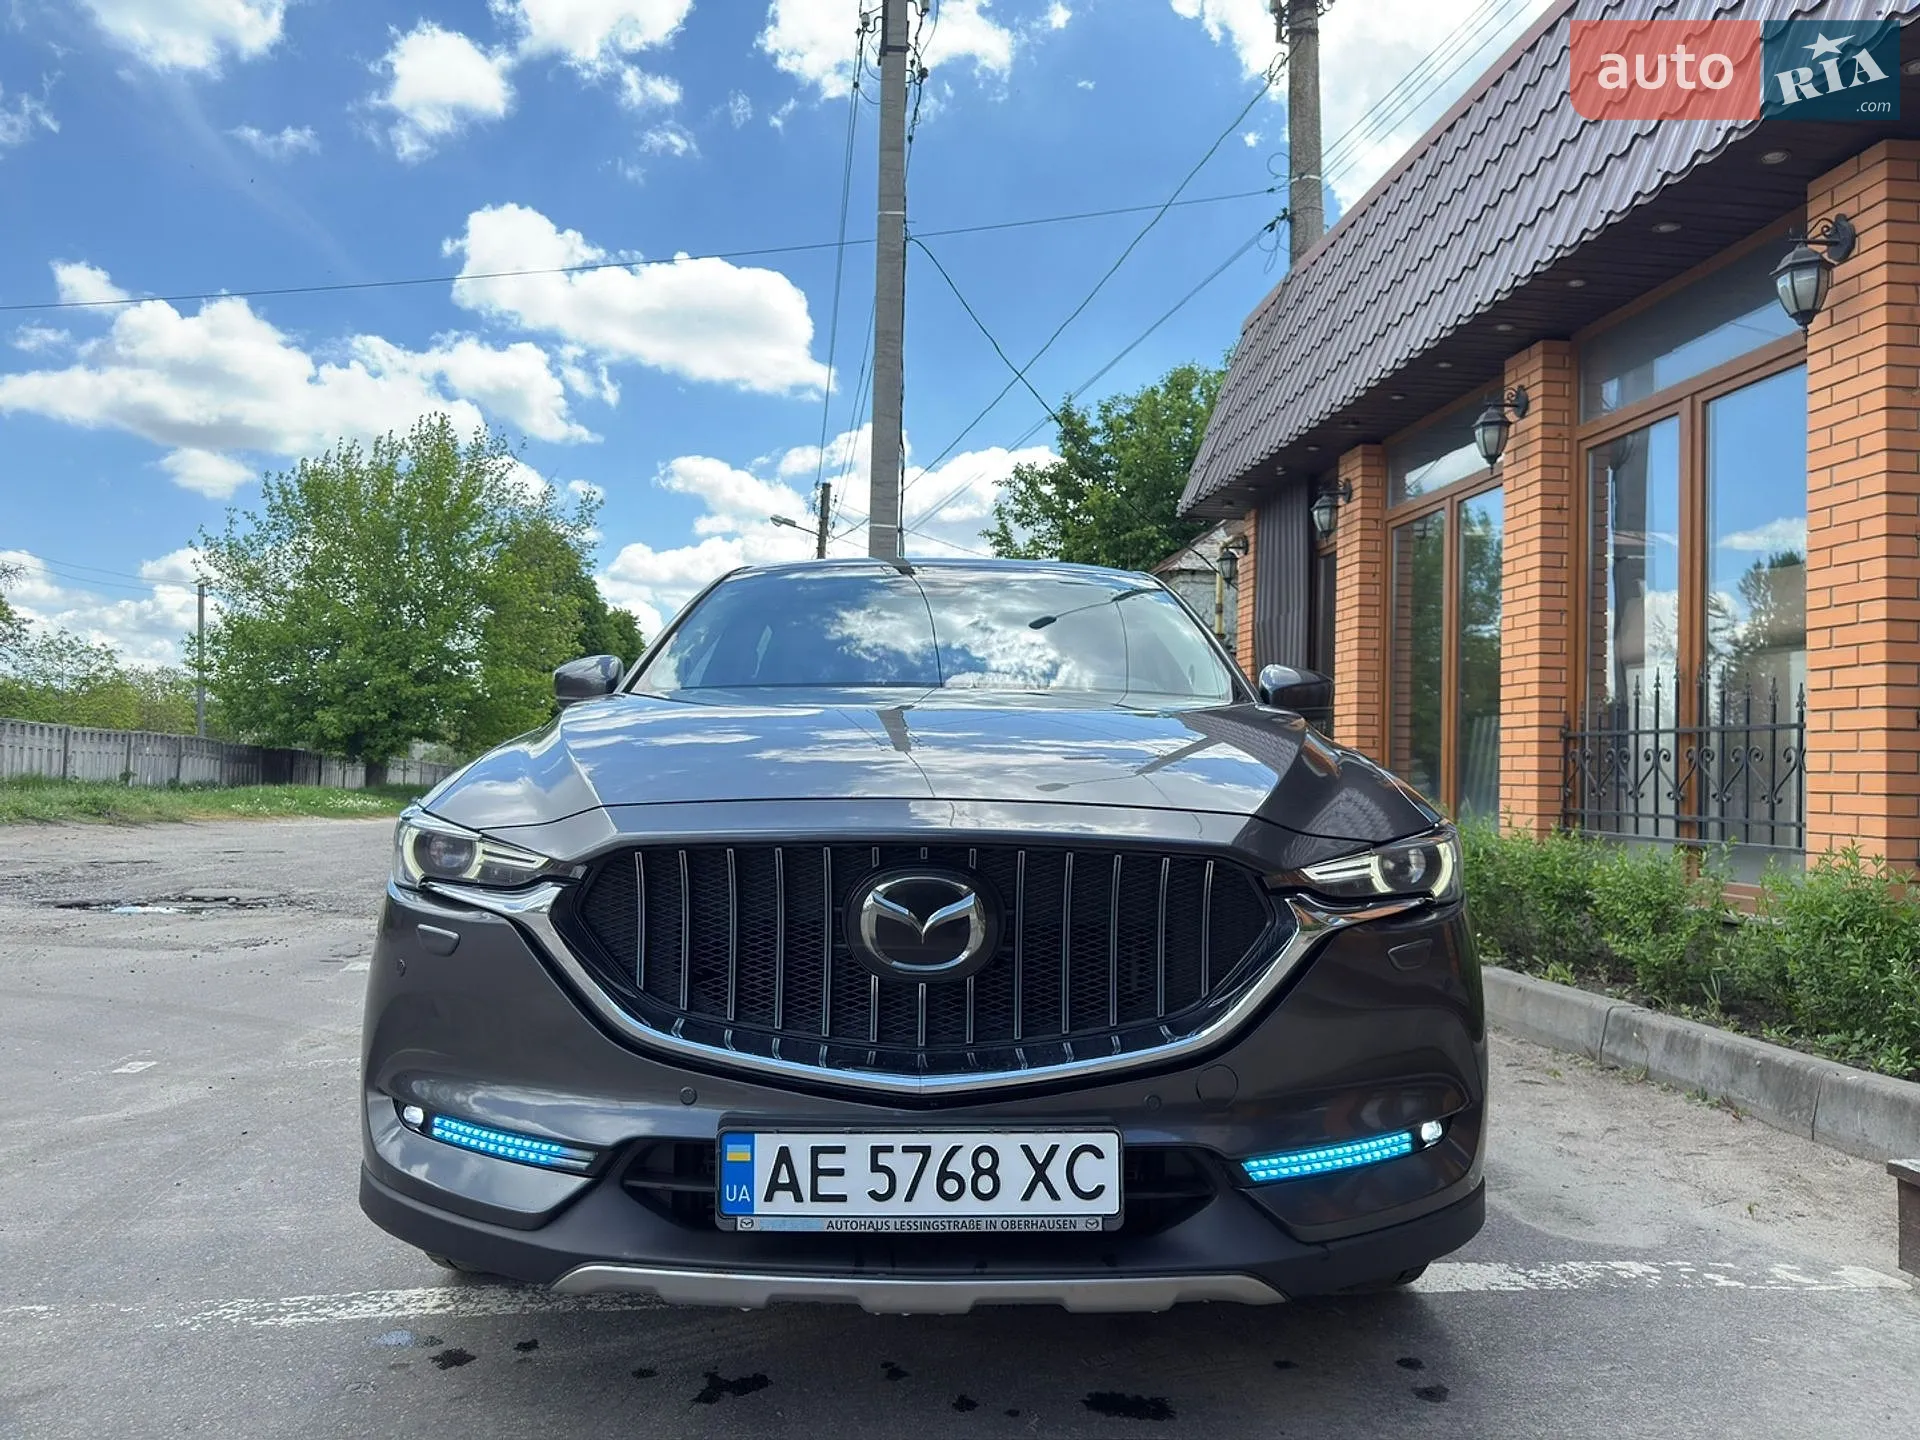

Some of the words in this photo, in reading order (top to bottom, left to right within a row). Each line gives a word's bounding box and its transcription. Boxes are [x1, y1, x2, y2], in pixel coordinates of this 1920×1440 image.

[763, 1144, 848, 1203] AE
[867, 1144, 1001, 1203] 5768
[1020, 1143, 1106, 1201] XC
[726, 1184, 751, 1202] UA
[826, 1218, 891, 1231] AUTOHAUS
[985, 1218, 997, 1230] IN
[1000, 1218, 1078, 1230] OBERHAUSEN
